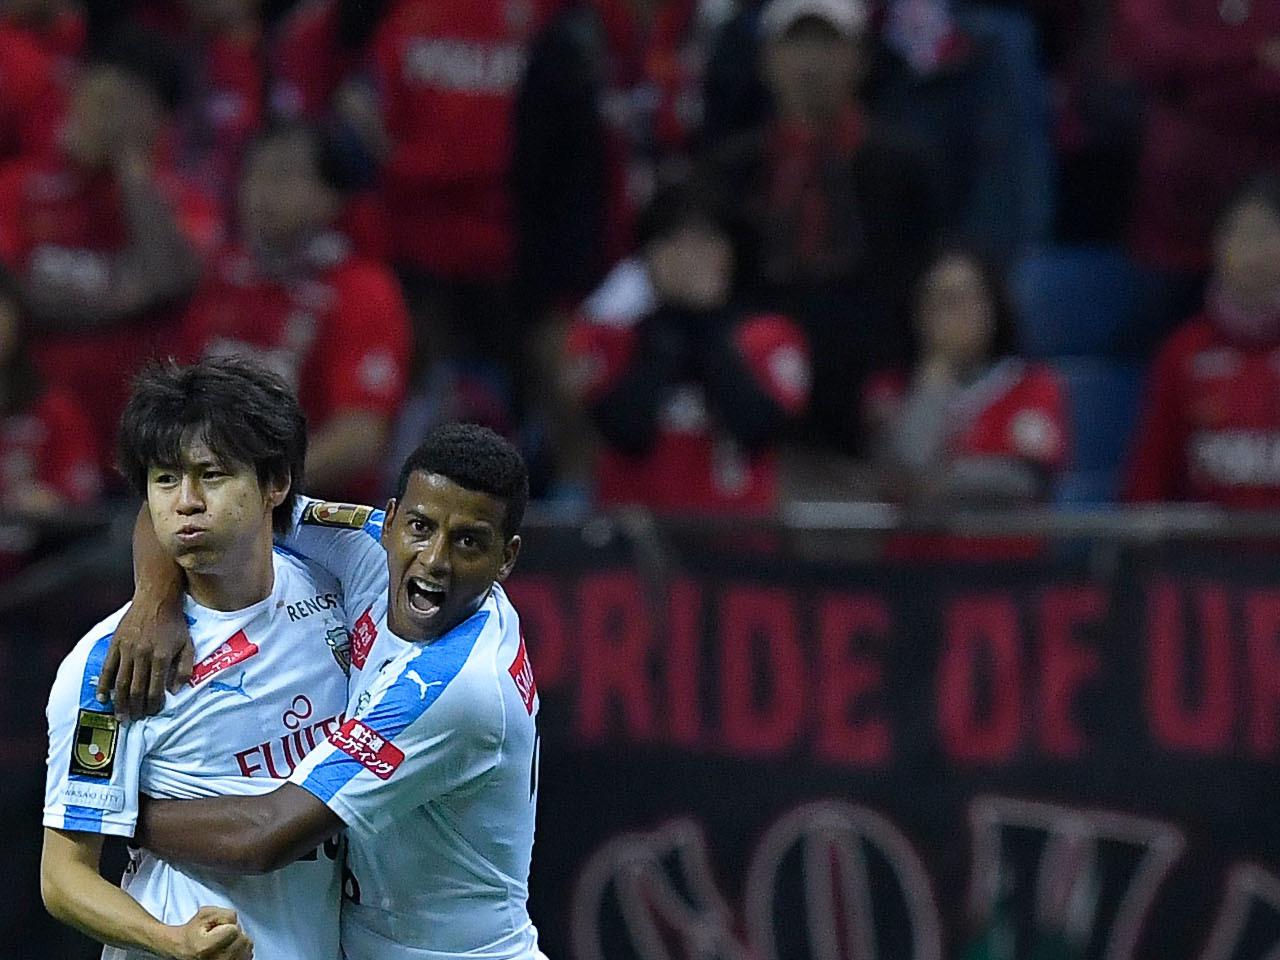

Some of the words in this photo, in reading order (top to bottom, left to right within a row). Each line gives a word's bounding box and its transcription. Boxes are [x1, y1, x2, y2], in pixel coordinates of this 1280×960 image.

[510, 568, 894, 766] PRIDE
[936, 584, 1106, 766] OF
[233, 711, 347, 780] FUJIT
[349, 723, 385, 753] 富士通
